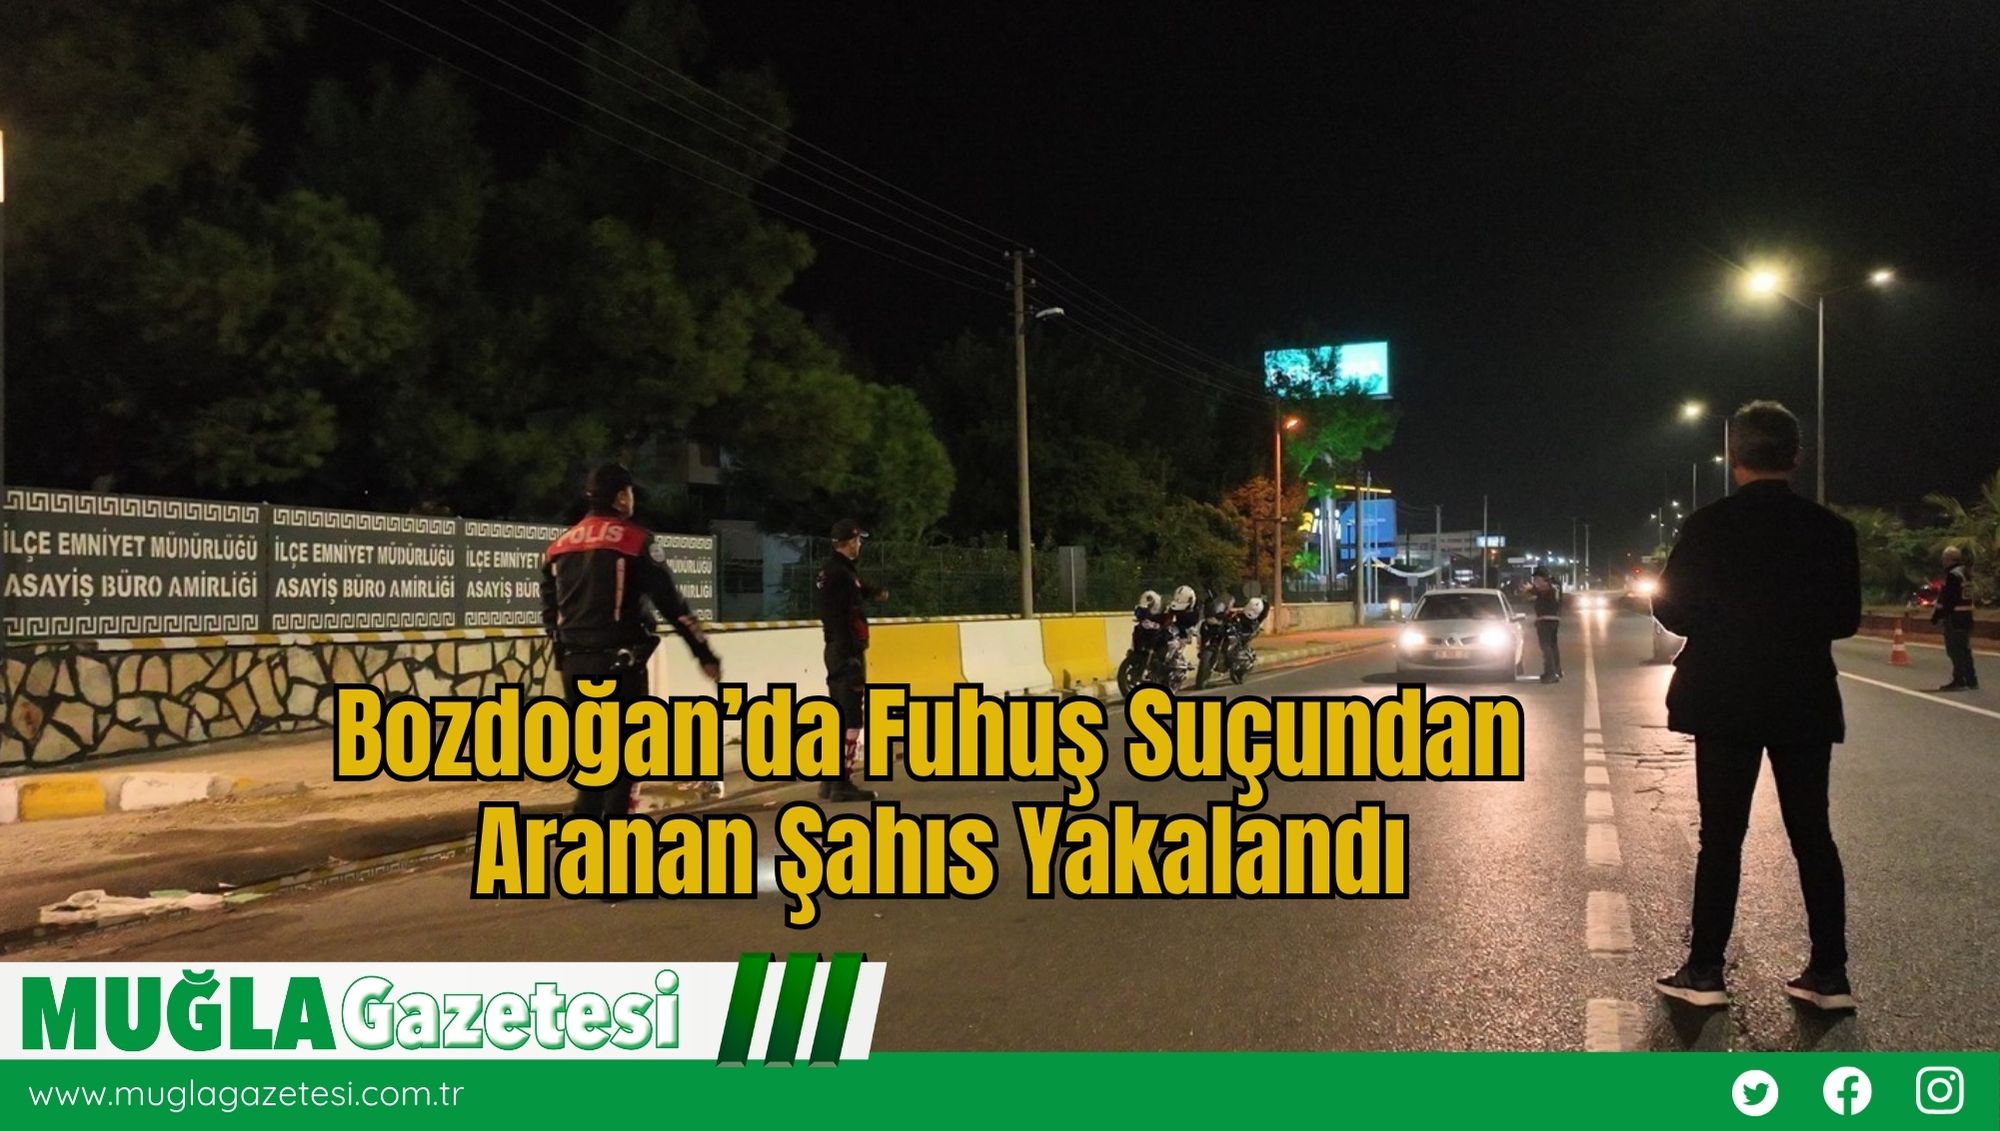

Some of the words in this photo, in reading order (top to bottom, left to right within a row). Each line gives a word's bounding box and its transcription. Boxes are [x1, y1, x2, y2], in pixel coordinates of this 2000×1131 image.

[3, 522, 51, 563] İLÇE
[58, 527, 146, 557] EMNİYET
[150, 530, 258, 561] MÜDÜRLÜĞÜ
[274, 535, 309, 569] İLÇE
[312, 539, 374, 565] EMNİYET
[377, 541, 456, 567] MÜDÜRLÜĞÜ
[466, 544, 491, 574] İLÇE
[493, 547, 540, 569] EMNİYET
[4, 567, 95, 606] ASAYİŞ
[101, 568, 163, 598] BÜRO
[168, 569, 258, 598] AMİRLİĞİ
[275, 572, 338, 605] ASAYİŞ
[342, 573, 386, 599] BÜRO
[389, 574, 456, 599] AMİRLİĞİ
[466, 576, 512, 605] ASAYİŞ
[515, 576, 540, 598] BÜR
